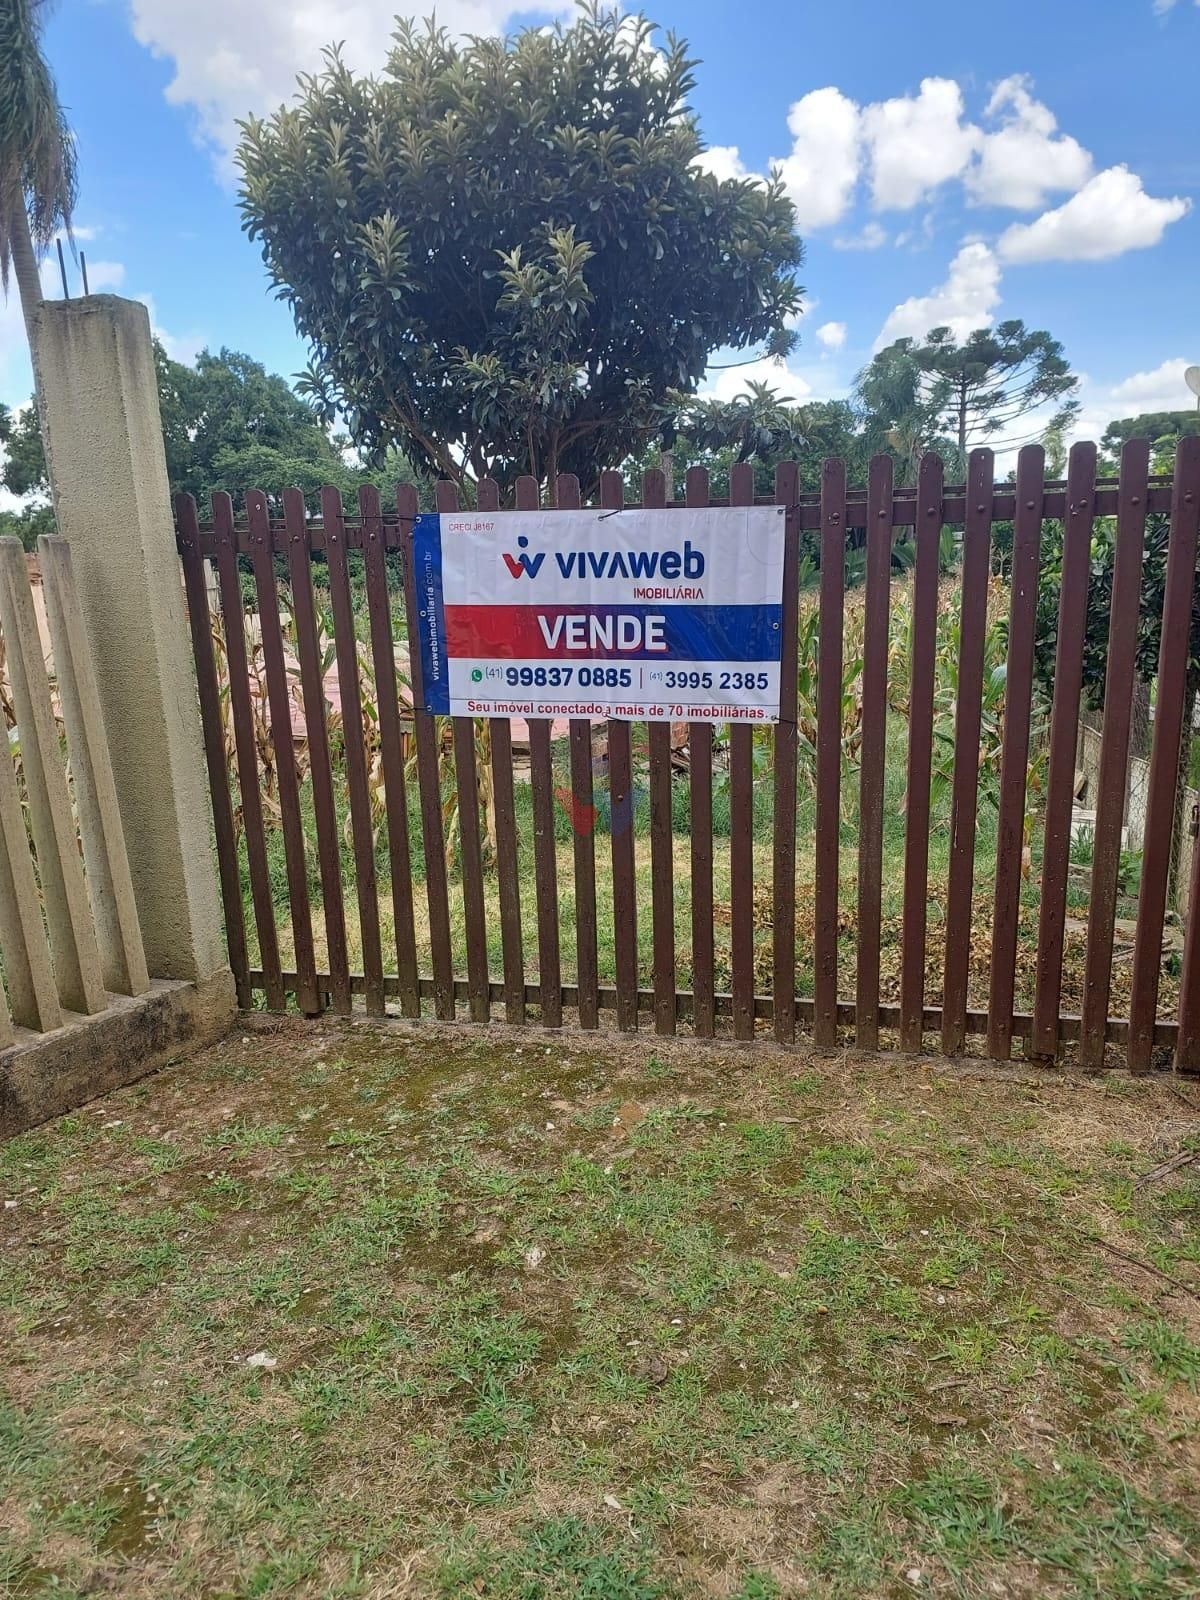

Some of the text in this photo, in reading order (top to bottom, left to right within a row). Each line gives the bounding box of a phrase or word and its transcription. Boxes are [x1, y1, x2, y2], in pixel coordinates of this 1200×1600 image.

[448, 522, 494, 532] CRECI J8167
[633, 585, 704, 599] IMOBILIÁRIA
[537, 615, 667, 650] VENDE
[485, 666, 503, 680] (41)
[665, 672, 712, 688] 3995
[719, 672, 768, 690] 2385
[467, 701, 490, 713] Seu
[494, 700, 534, 714] imóvel
[538, 701, 602, 715] conectado
[615, 705, 645, 716] mais
[649, 705, 664, 716] de
[668, 706, 683, 717] 70
[687, 706, 768, 719] imobiliárias.
